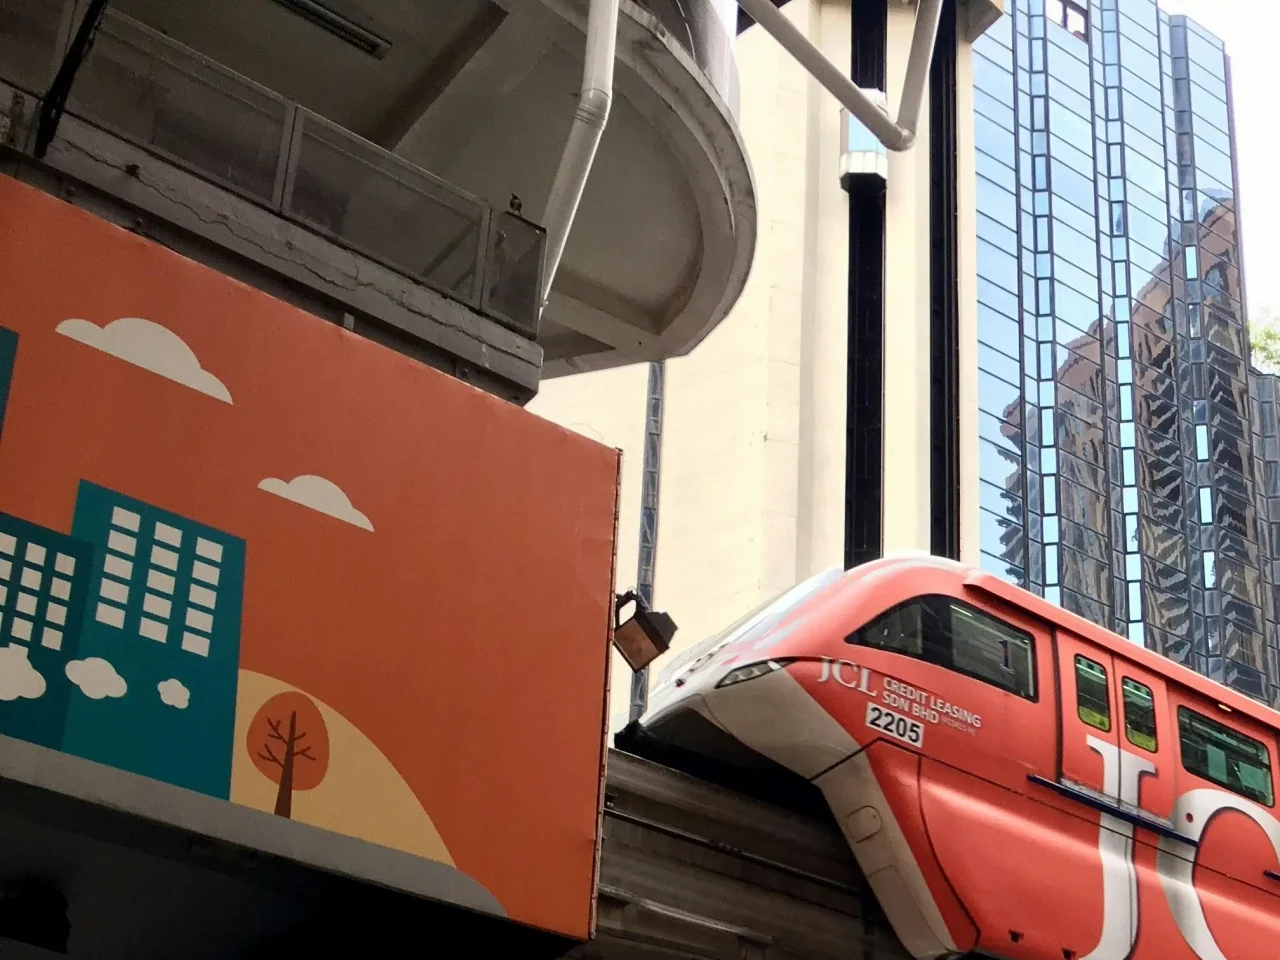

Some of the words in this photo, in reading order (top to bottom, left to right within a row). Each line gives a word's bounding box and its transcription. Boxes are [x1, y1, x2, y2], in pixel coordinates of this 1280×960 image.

[817, 655, 878, 697] JCL
[882, 691, 909, 711] SDN
[912, 704, 940, 724] BHD
[883, 677, 928, 705] CREDIT
[930, 696, 982, 728] LEASING
[869, 707, 921, 743] 2205
